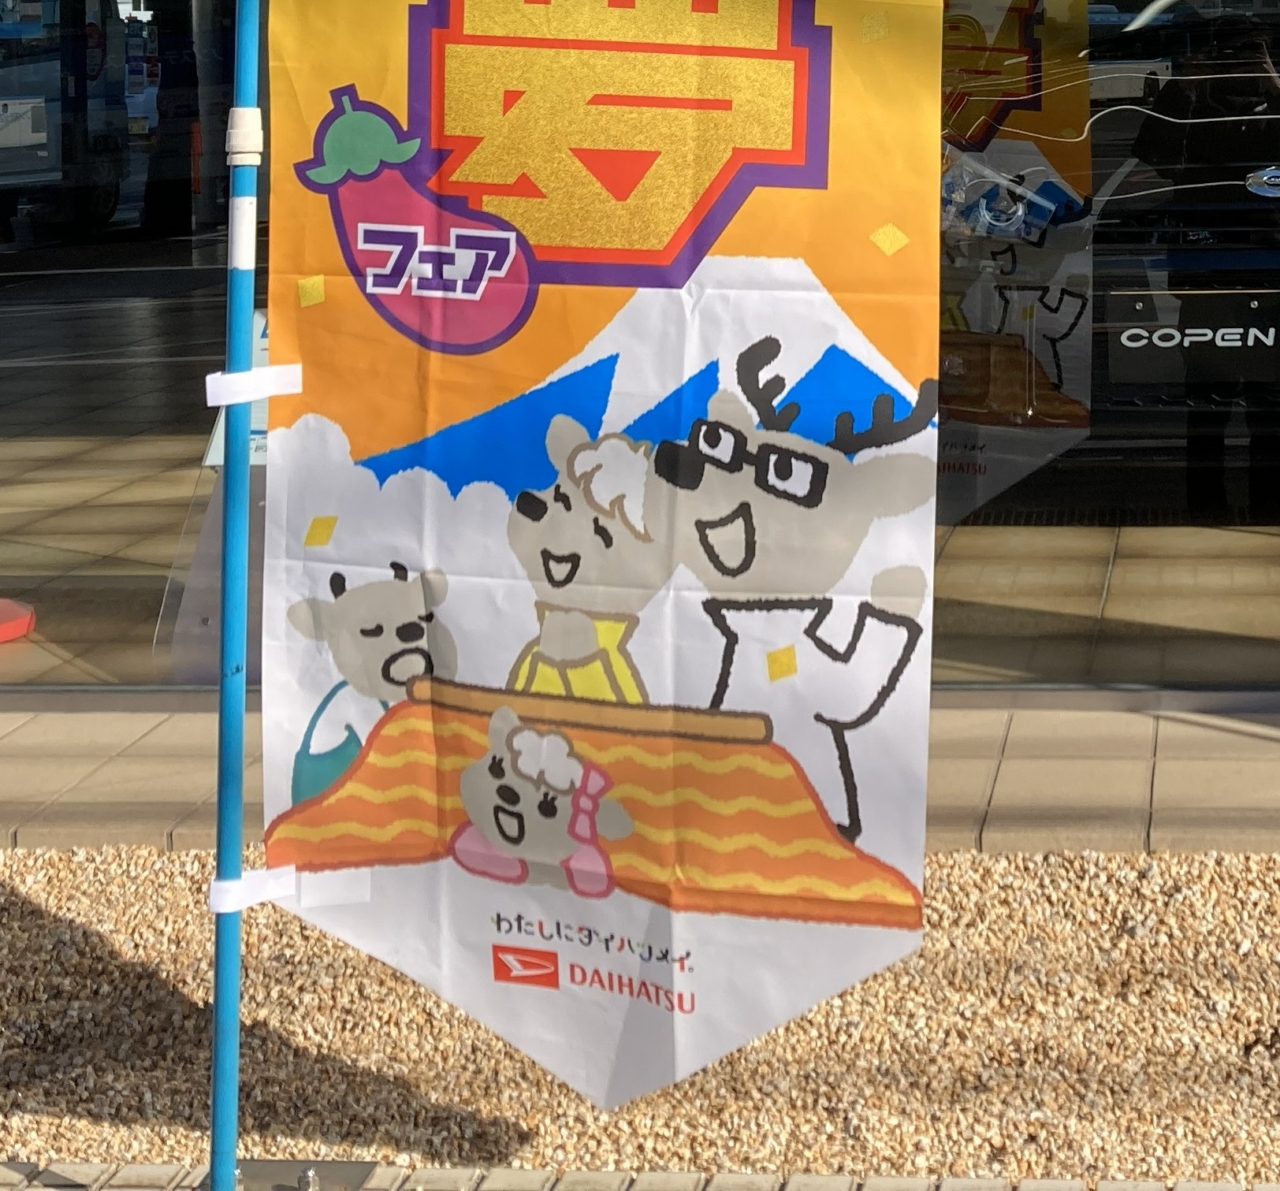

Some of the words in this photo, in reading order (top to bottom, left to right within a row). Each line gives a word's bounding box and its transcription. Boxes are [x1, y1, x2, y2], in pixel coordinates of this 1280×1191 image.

[357, 222, 517, 301] フェア
[1119, 326, 1276, 349] COPEN
[569, 961, 696, 1015] DAIHATSU
